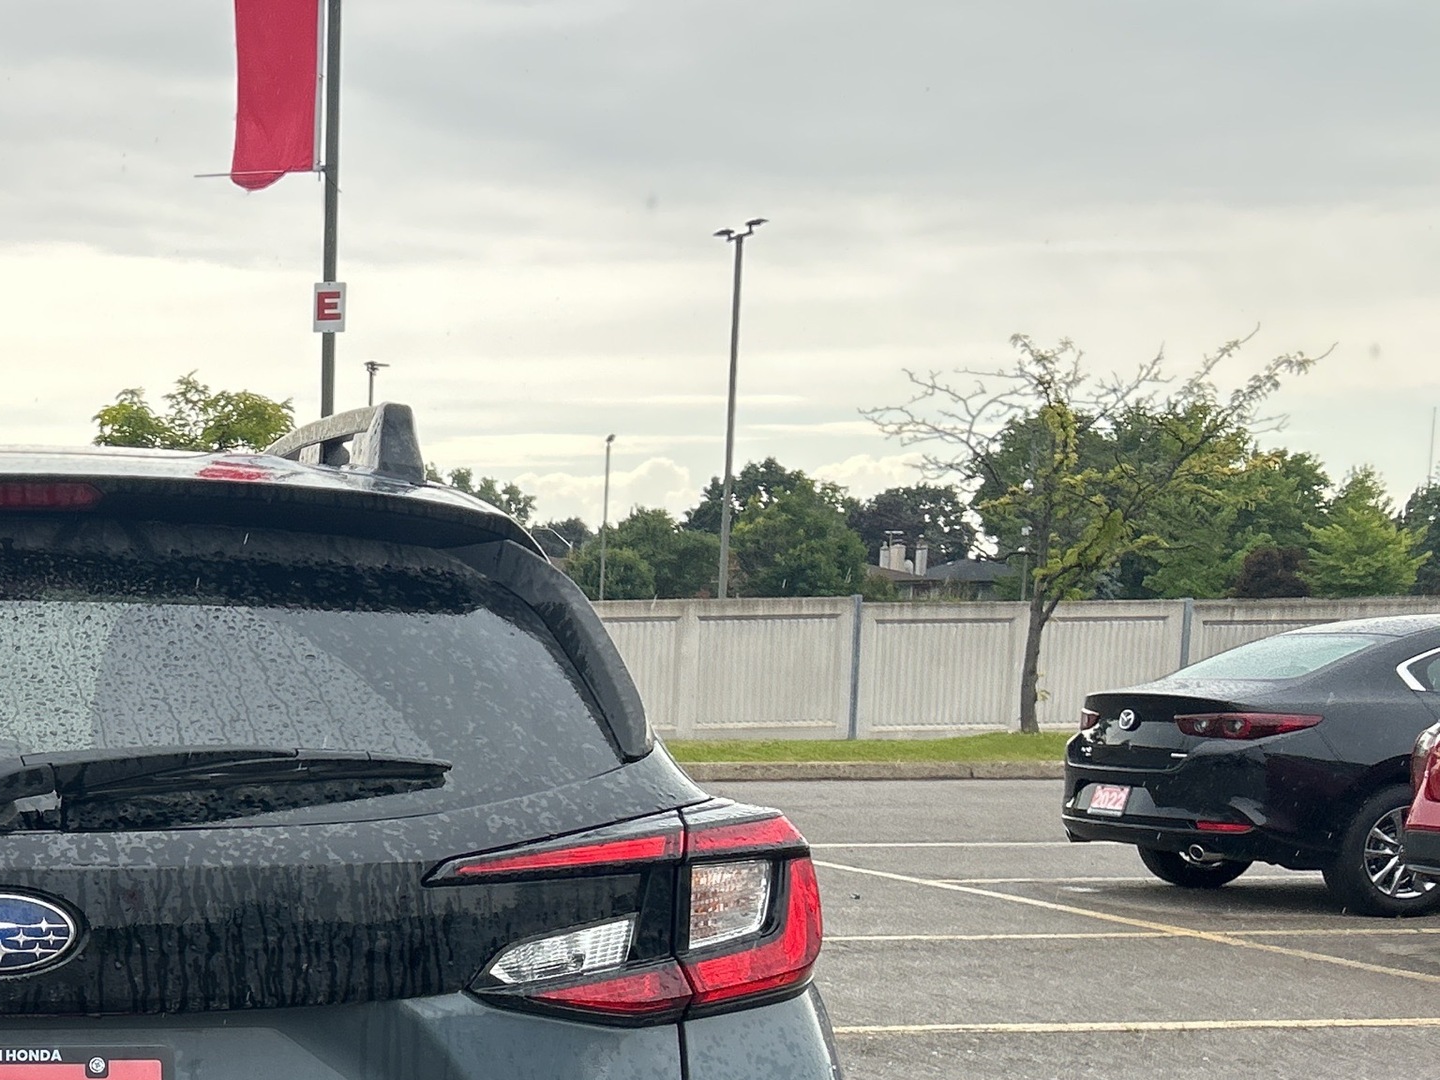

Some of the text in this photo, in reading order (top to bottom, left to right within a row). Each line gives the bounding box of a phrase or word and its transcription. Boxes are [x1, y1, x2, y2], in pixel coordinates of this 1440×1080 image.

[317, 291, 341, 321] E
[1093, 790, 1126, 809] 2022
[5, 1048, 62, 1062] HONDA
